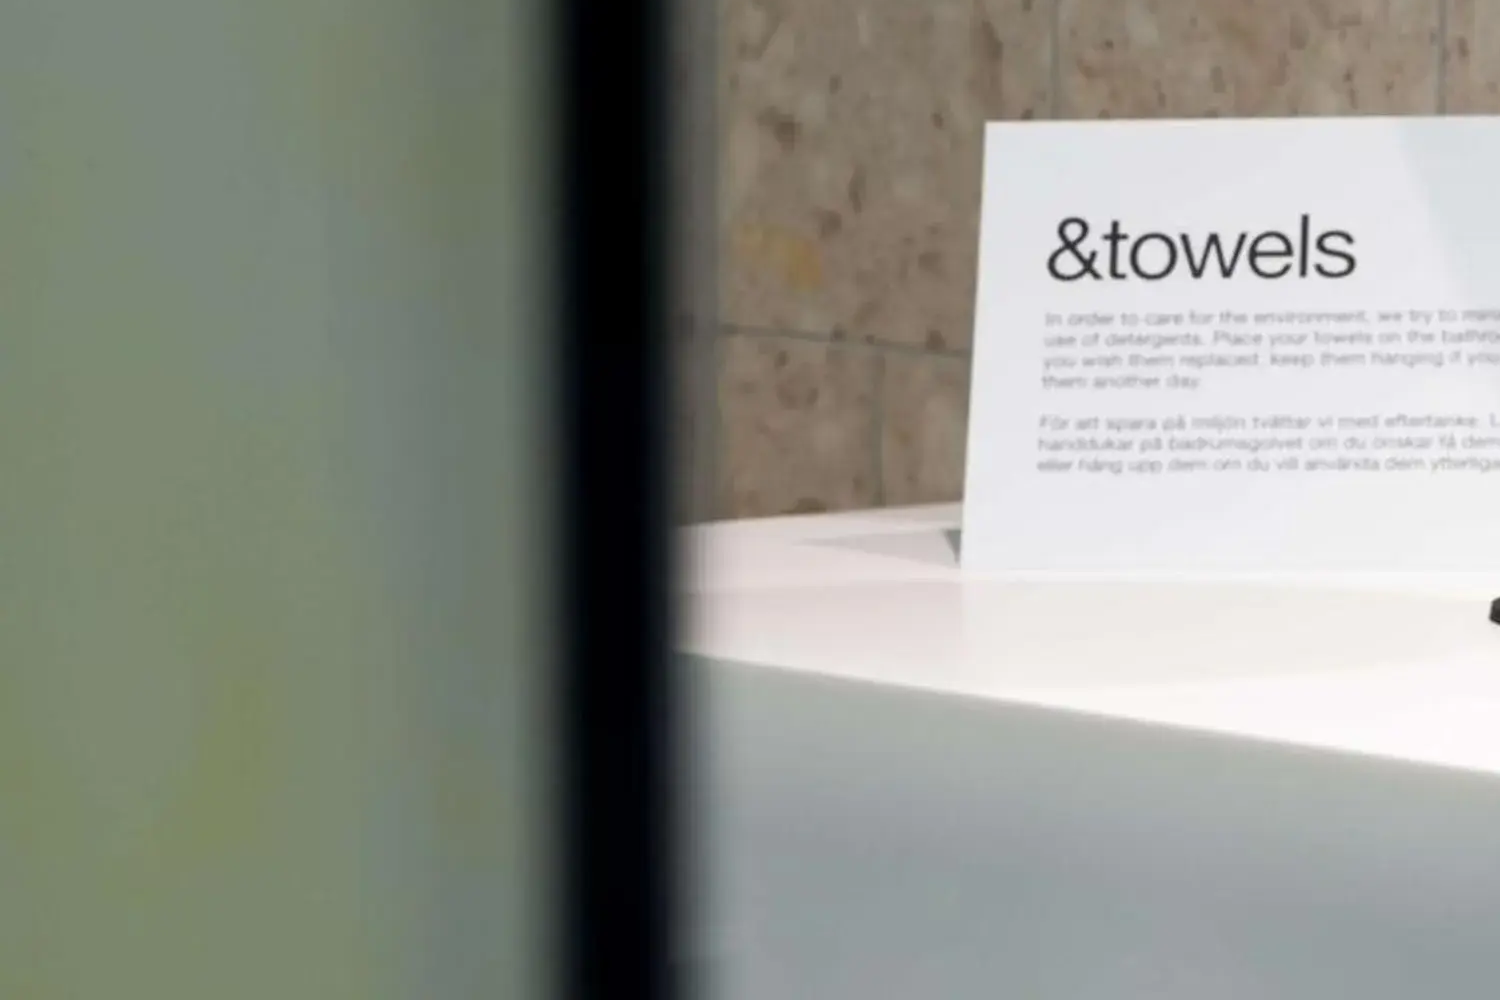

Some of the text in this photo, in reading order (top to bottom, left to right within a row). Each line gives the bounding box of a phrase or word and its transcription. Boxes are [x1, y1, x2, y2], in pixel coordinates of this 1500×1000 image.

[1047, 214, 1357, 281] &towels
[1045, 310, 1062, 326] In
[1068, 310, 1113, 326] order
[1121, 309, 1138, 325] to
[1145, 312, 1182, 325] care
[1189, 309, 1214, 325] for
[1219, 308, 1248, 324] the
[1377, 310, 1401, 323] we
[1409, 307, 1434, 326] try
[1438, 307, 1457, 323] to
[1044, 335, 1076, 347] use
[1081, 332, 1099, 347] of
[1213, 330, 1262, 345] Place
[1270, 333, 1308, 348] your
[1313, 330, 1372, 345] towels
[1377, 332, 1401, 344] on
[1407, 329, 1435, 344] the
[1044, 357, 1076, 371] you
[1082, 354, 1123, 368] wish
[1129, 353, 1174, 367] them
[1270, 352, 1315, 369] keep
[1320, 352, 1365, 366] them
[1371, 351, 1443, 368] hanging
[1042, 374, 1087, 389] them
[1093, 373, 1159, 388] another
[1039, 415, 1069, 430] För
[1075, 415, 1099, 430] att
[1162, 414, 1186, 432] på
[1316, 413, 1333, 428] vi
[1338, 412, 1379, 427] med
[1139, 436, 1163, 453] på
[1308, 438, 1338, 449] om
[1343, 434, 1366, 448] du
[1128, 460, 1163, 474] upp
[1168, 457, 1206, 471] dem
[1212, 460, 1242, 471] om
[1247, 456, 1271, 470] du
[1385, 455, 1426, 469] dem
